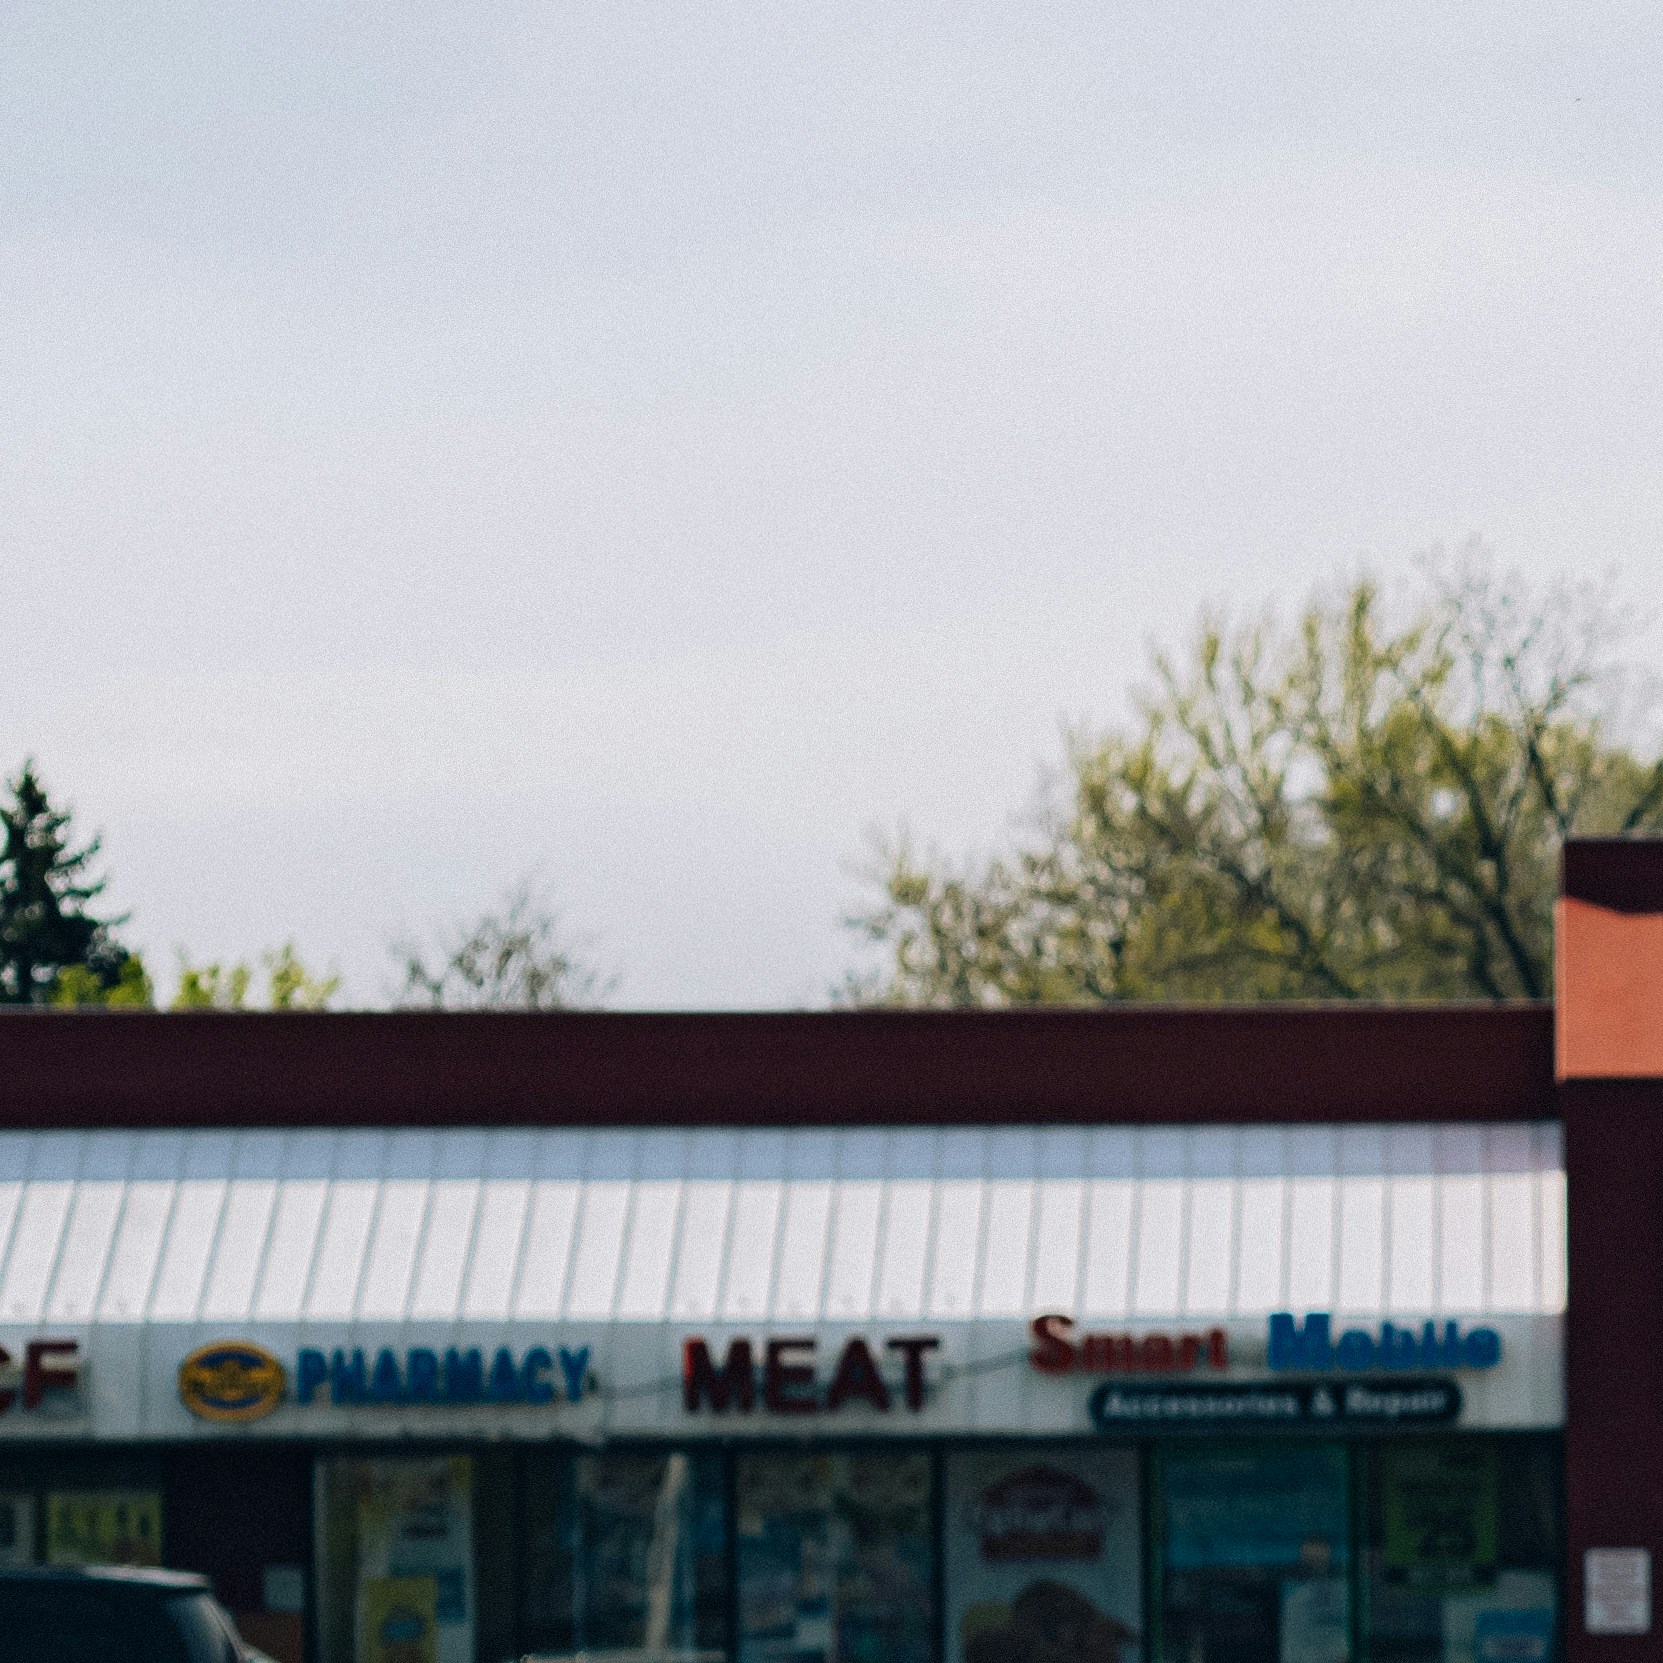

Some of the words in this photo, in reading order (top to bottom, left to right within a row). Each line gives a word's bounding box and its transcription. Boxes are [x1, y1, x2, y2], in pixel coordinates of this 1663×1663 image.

[1029, 1313, 1228, 1375] Smart
[1267, 1312, 1502, 1372] Mobile
[297, 1346, 590, 1405] PHARMACY
[682, 1337, 940, 1414] MEAT
[1103, 1389, 1299, 1419] Accessories
[1311, 1388, 1335, 1418] &
[1346, 1385, 1448, 1418] Repair
